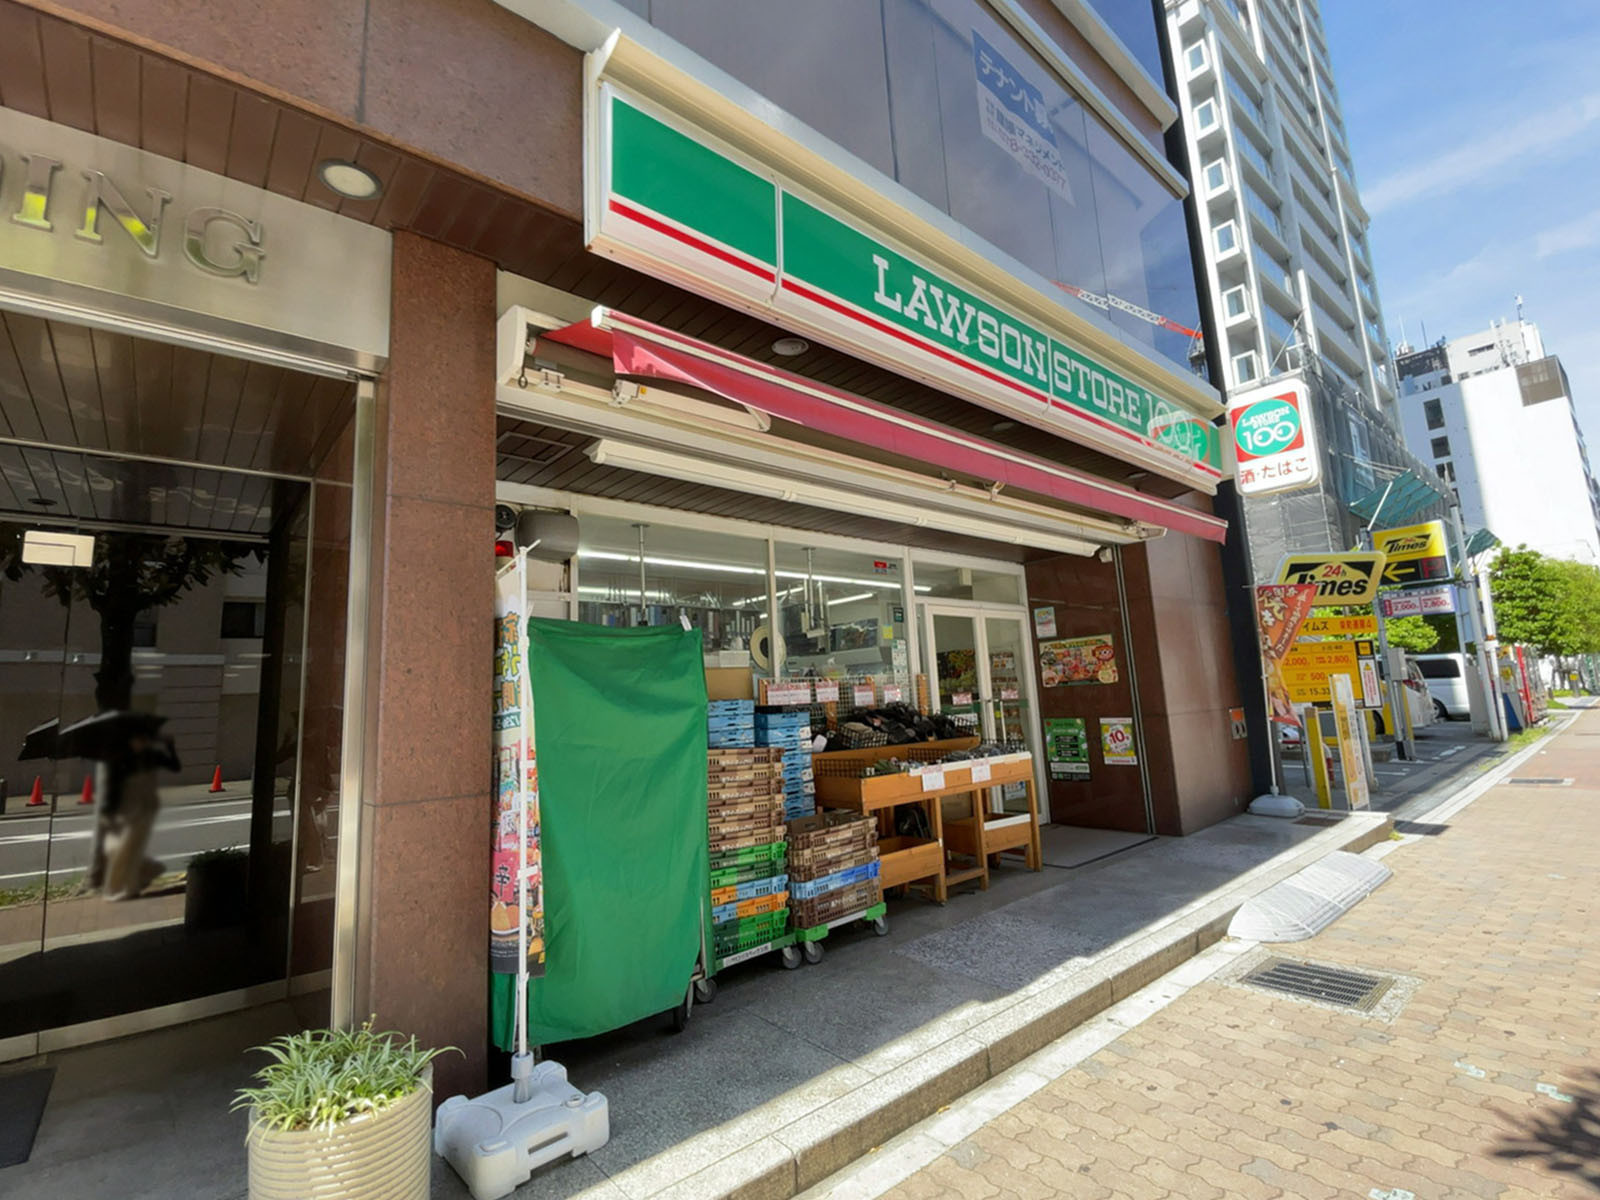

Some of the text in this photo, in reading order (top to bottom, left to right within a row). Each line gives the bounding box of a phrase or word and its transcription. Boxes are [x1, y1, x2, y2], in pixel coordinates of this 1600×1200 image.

[0, 153, 266, 284] ING
[872, 254, 1048, 382] LAWSON
[1053, 350, 1142, 425] STORE
[1242, 420, 1296, 452] 100
[1385, 534, 1428, 553] Times
[1422, 558, 1443, 579] P
[1303, 620, 1329, 632] イムス
